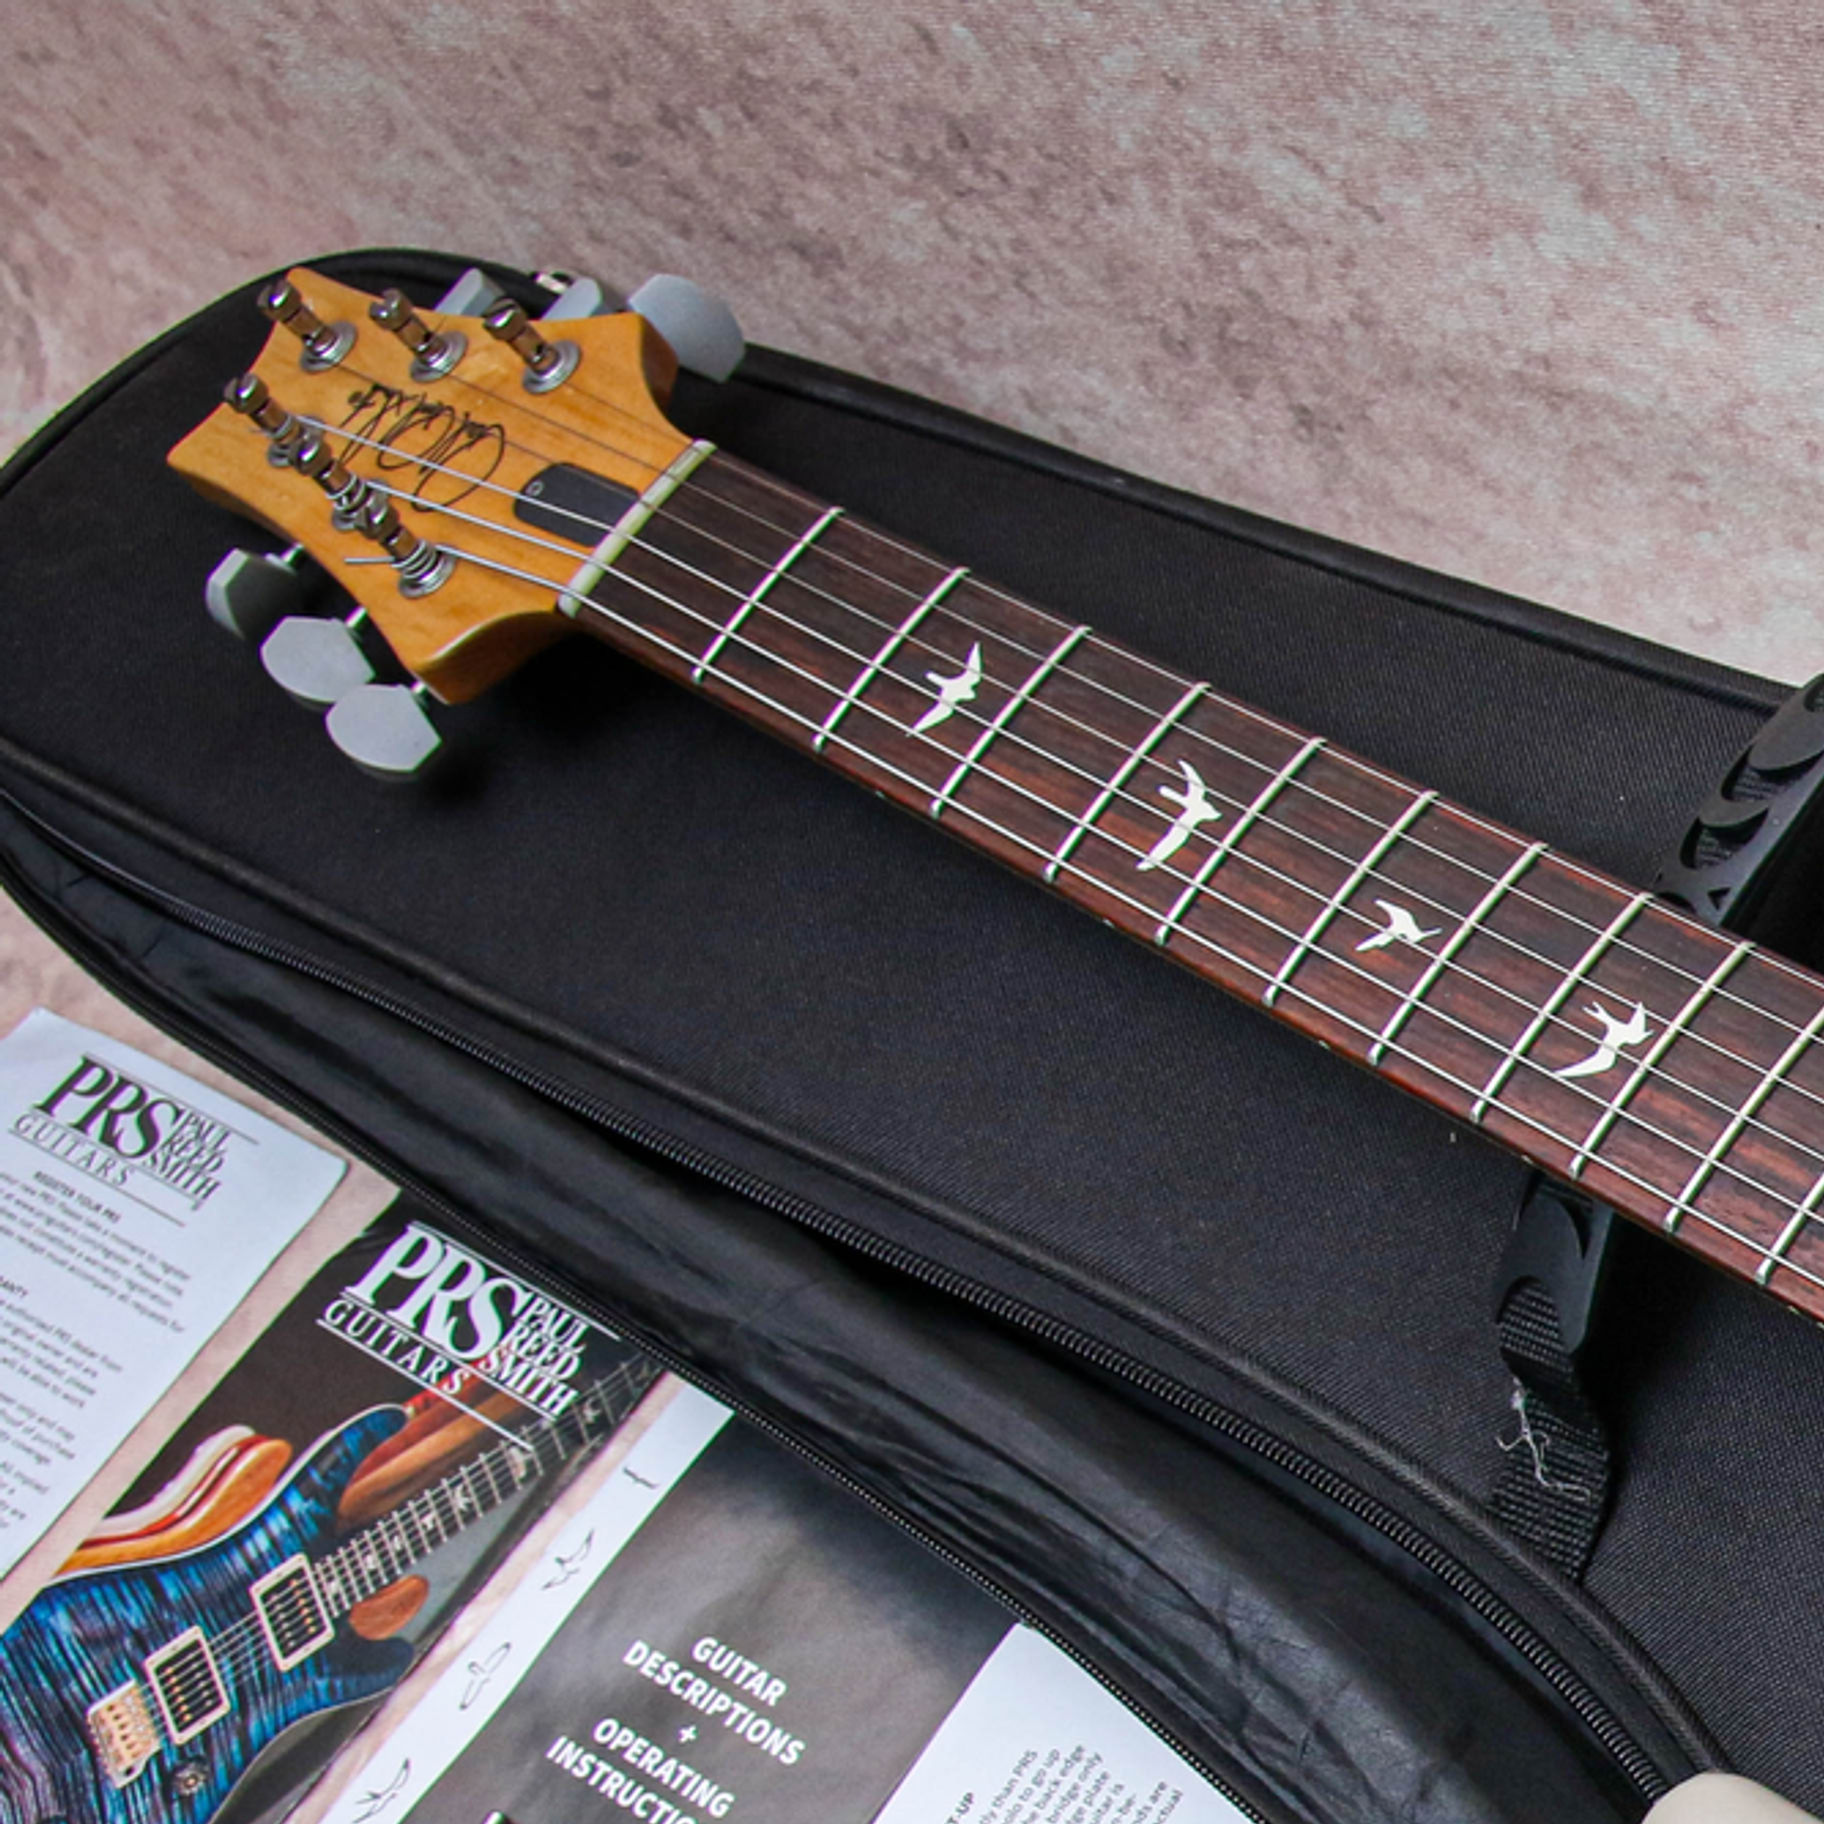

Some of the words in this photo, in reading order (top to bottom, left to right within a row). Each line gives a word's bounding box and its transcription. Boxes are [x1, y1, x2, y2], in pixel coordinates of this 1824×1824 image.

[33, 1054, 183, 1159] PRS
[174, 1106, 232, 1150] PAUL
[14, 1112, 130, 1186] GUITARS
[142, 1150, 221, 1202] SMITH
[163, 1130, 227, 1174] REED
[76, 1193, 102, 1212] YOUR
[102, 1208, 120, 1223] PRS
[344, 1223, 534, 1361] PRS
[522, 1293, 588, 1348] PAUL
[323, 1299, 471, 1395] GUITARS
[479, 1345, 579, 1416] SMITH
[499, 1320, 584, 1381] REED
[623, 1640, 805, 1765] DESCRIPTIONS
[692, 1637, 787, 1705] GUITAR
[593, 1718, 735, 1818] OPERATING
[991, 1777, 1018, 1808] than
[1012, 1750, 1037, 1776] PRS
